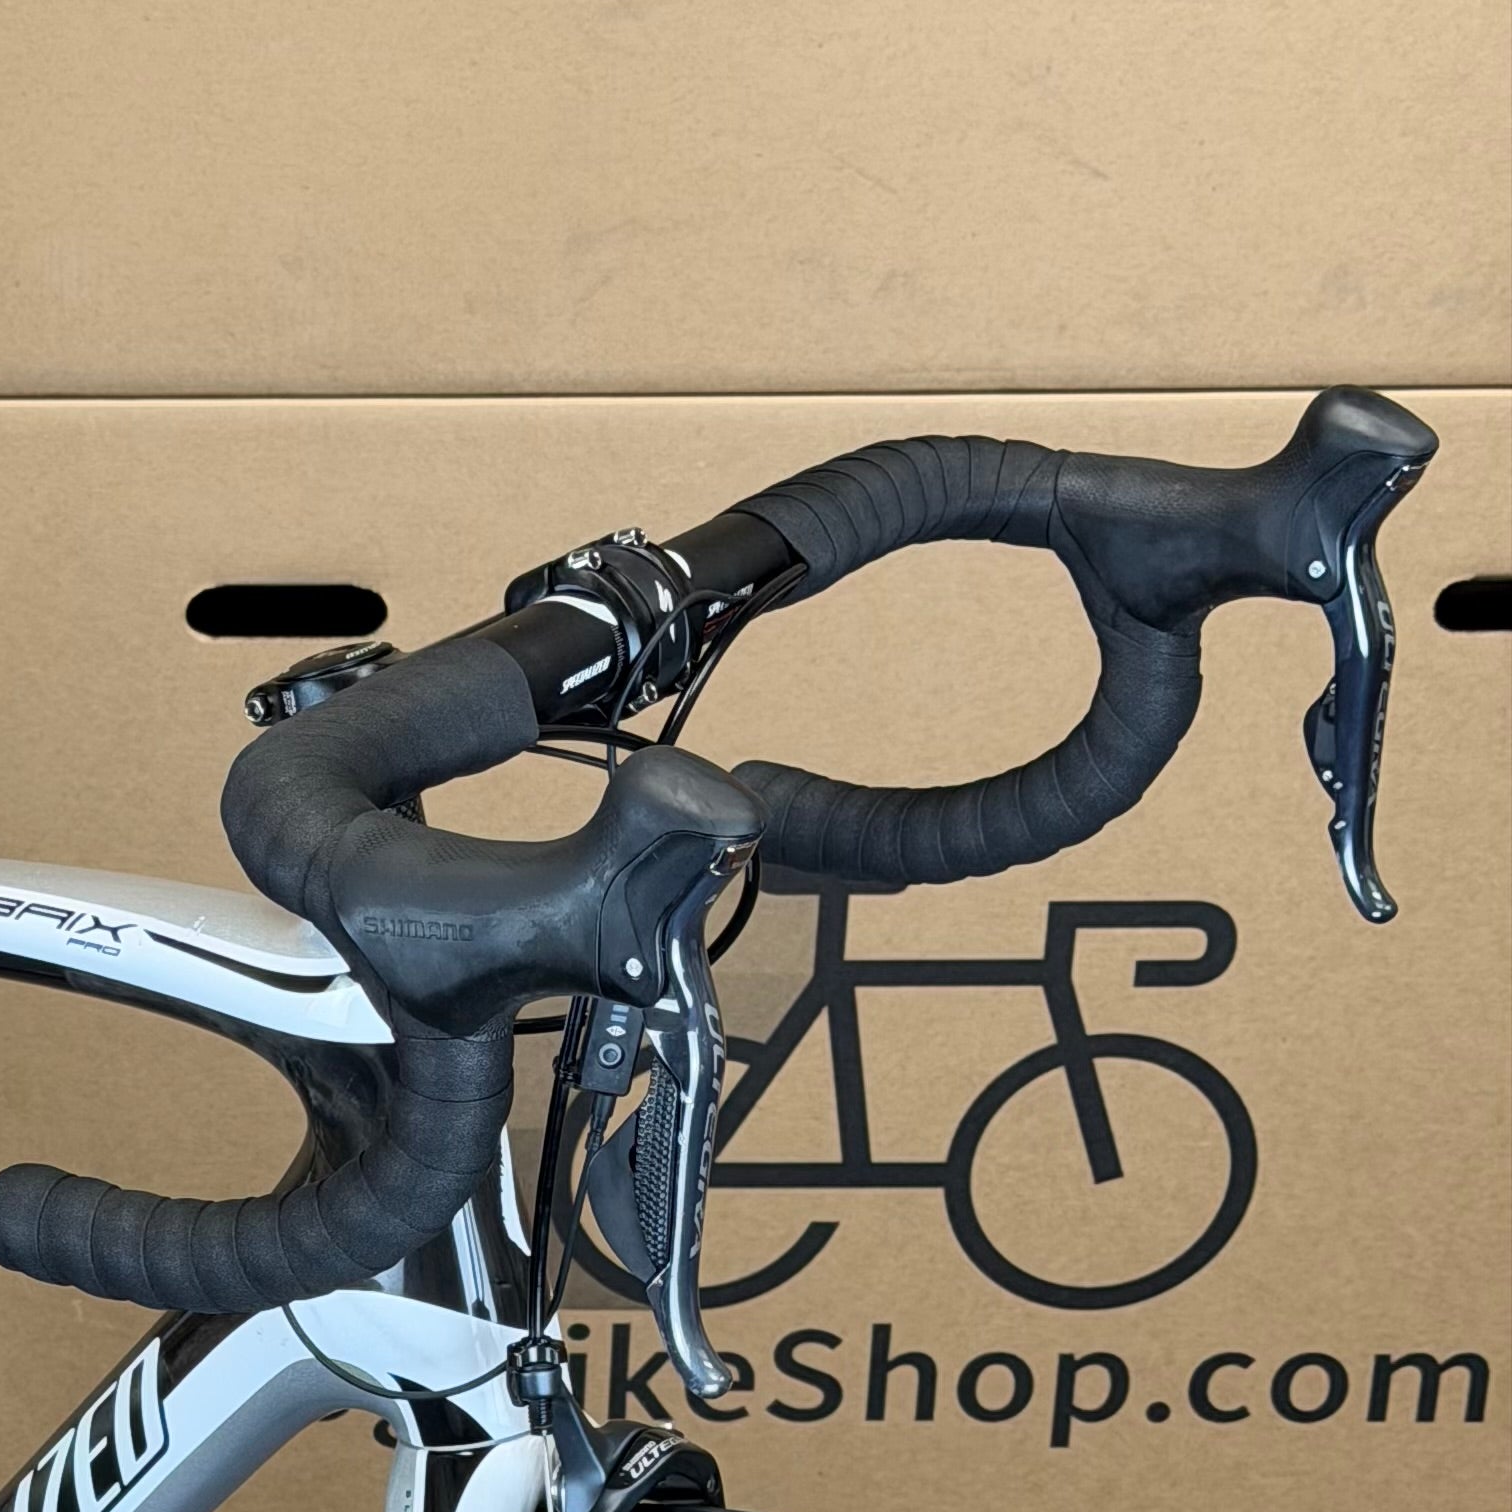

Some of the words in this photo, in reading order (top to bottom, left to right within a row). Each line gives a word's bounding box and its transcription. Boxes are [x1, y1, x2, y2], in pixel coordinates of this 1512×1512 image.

[560, 654, 611, 695] SPECIALIZED
[364, 916, 473, 941] SHIMANO
[66, 937, 121, 957] PRO
[567, 1322, 1489, 1449] ikeShop.com
